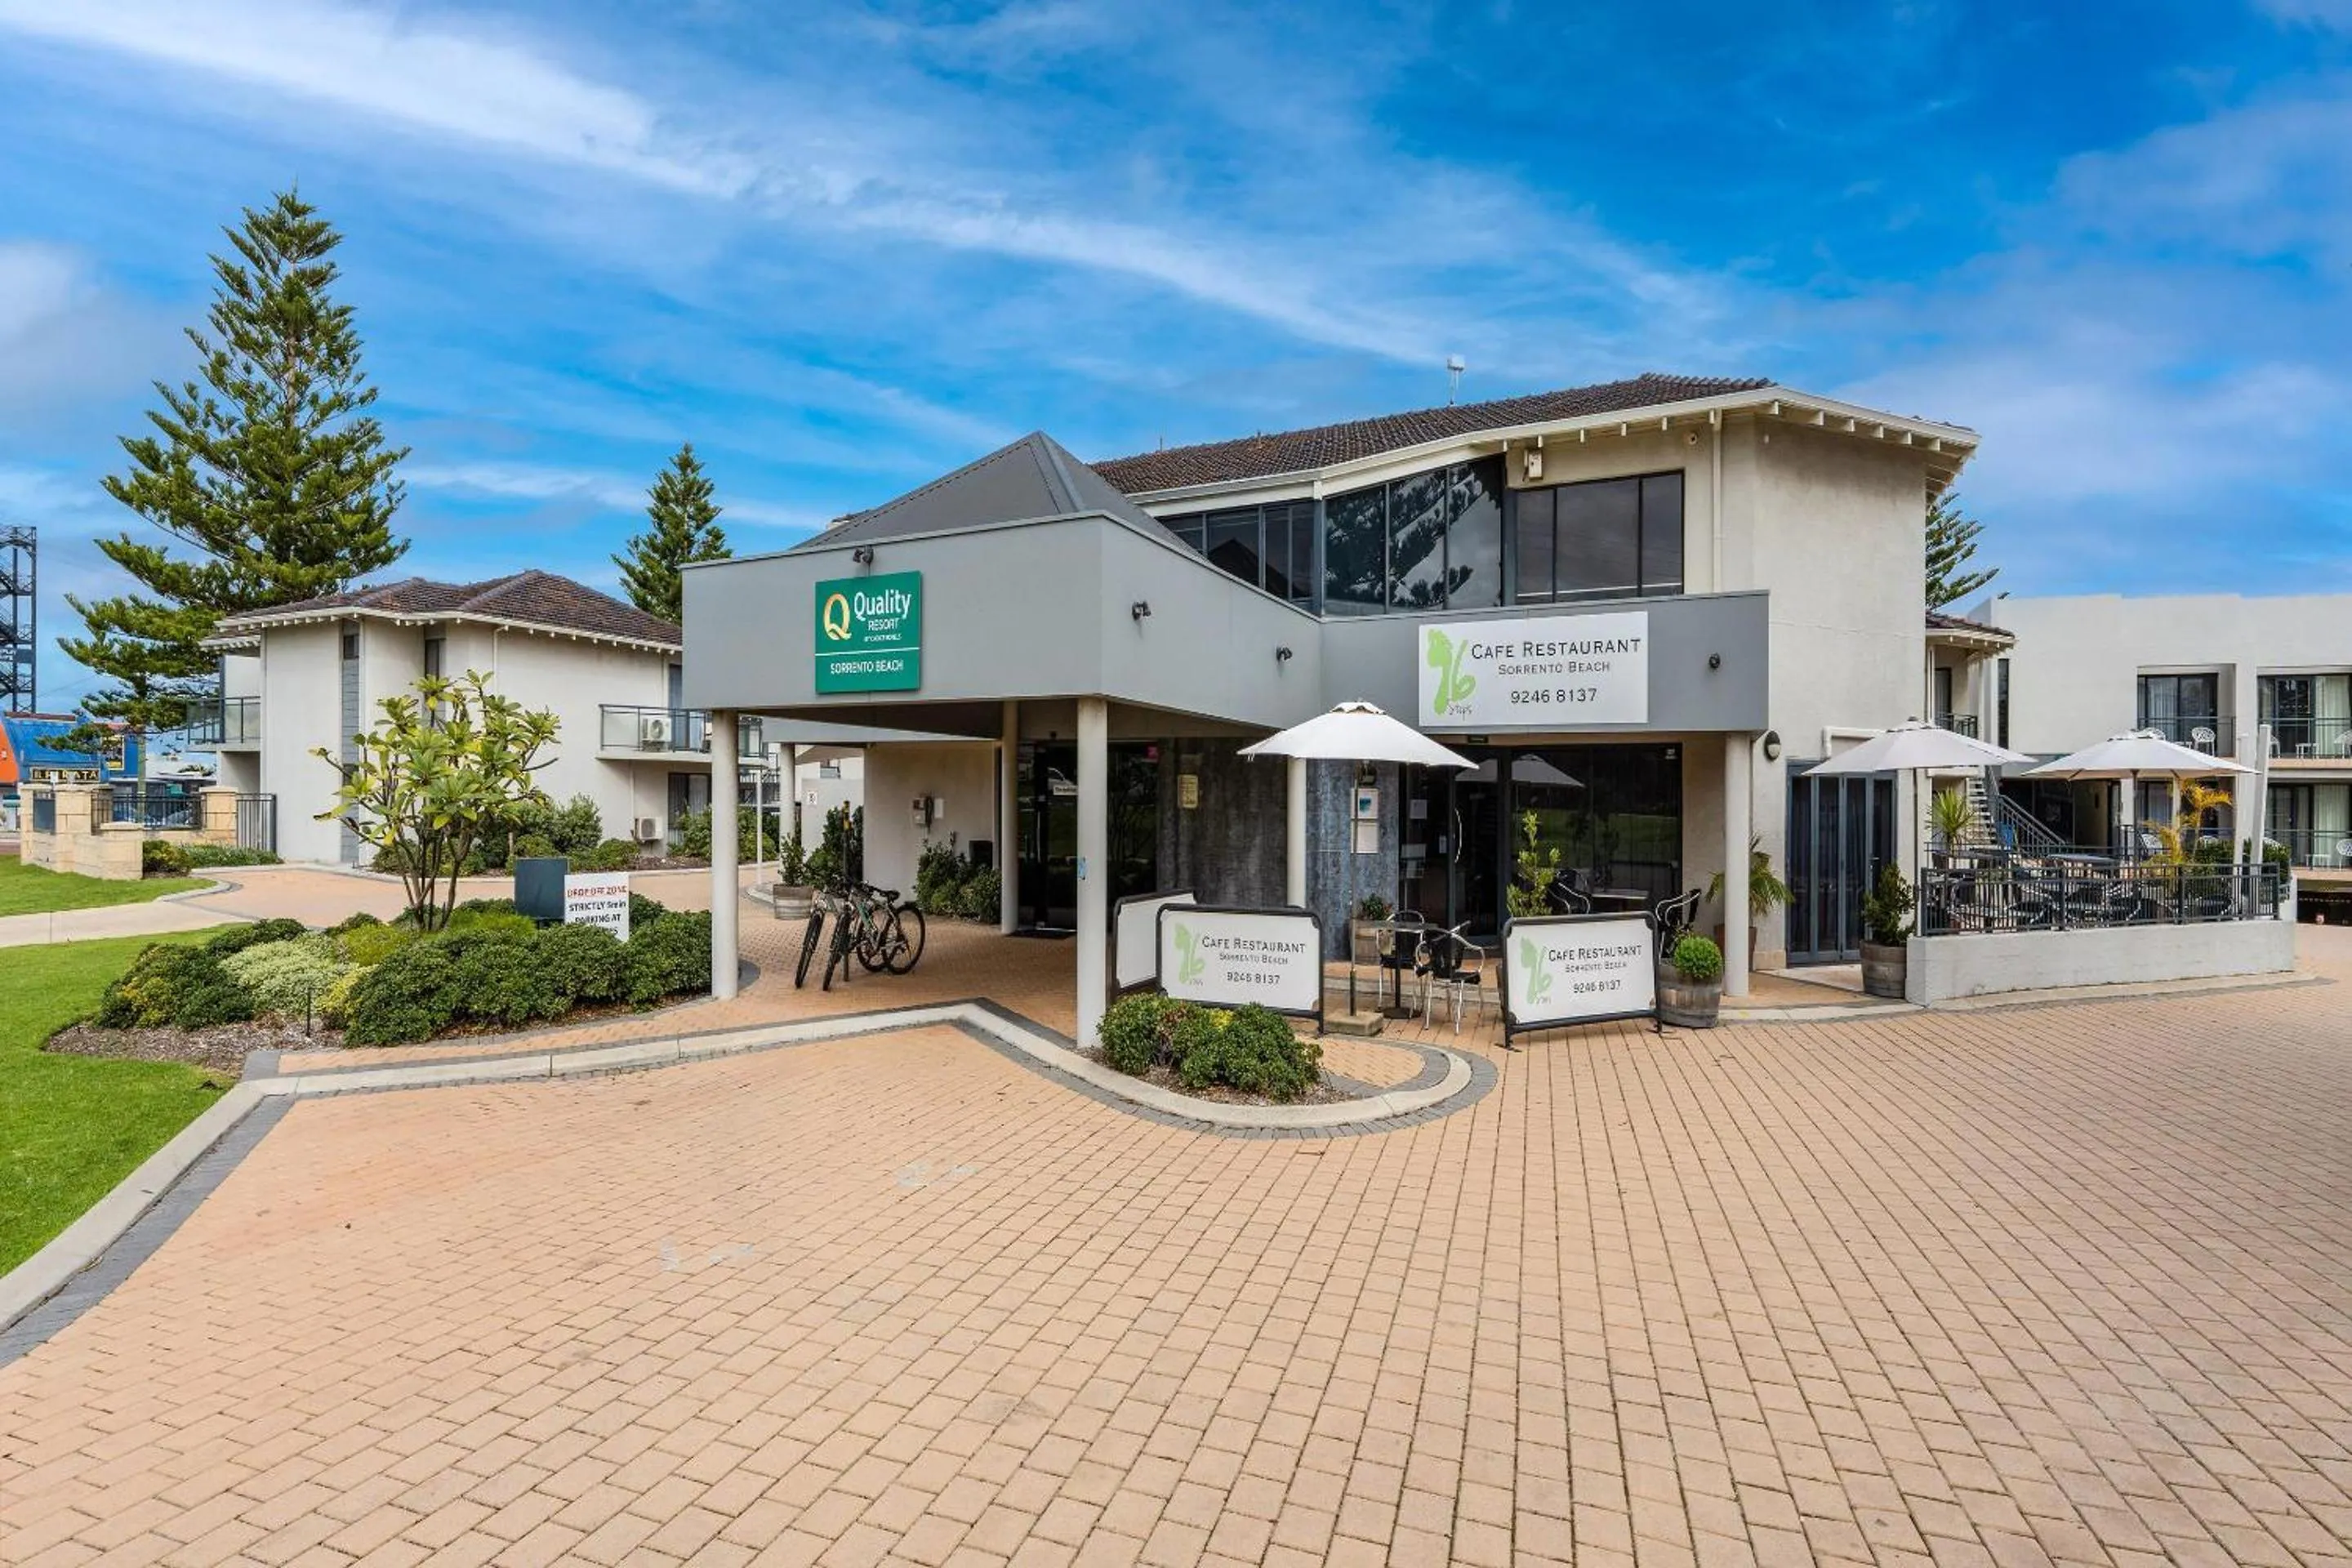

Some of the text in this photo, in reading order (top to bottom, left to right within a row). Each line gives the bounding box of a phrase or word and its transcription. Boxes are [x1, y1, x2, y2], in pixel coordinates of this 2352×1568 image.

[853, 589, 911, 621] Quality
[823, 593, 852, 640] Q
[868, 617, 900, 630] RESORT
[1472, 639, 1642, 660] CAFE RESTAURANT
[830, 659, 904, 675] SORRENTO BEACH
[1498, 661, 1610, 675] SORRENTO BEACH
[1510, 688, 1597, 704] 9246 8137
[568, 901, 605, 911] STRICTLY
[612, 914, 621, 922] AT
[1202, 936, 1305, 953] CAFE RESTAURANT
[1262, 955, 1288, 964] BEACH
[1548, 945, 1642, 961] CAFE RESTAURANT
[1255, 973, 1280, 984] 8137
[1599, 980, 1620, 991] 8137
